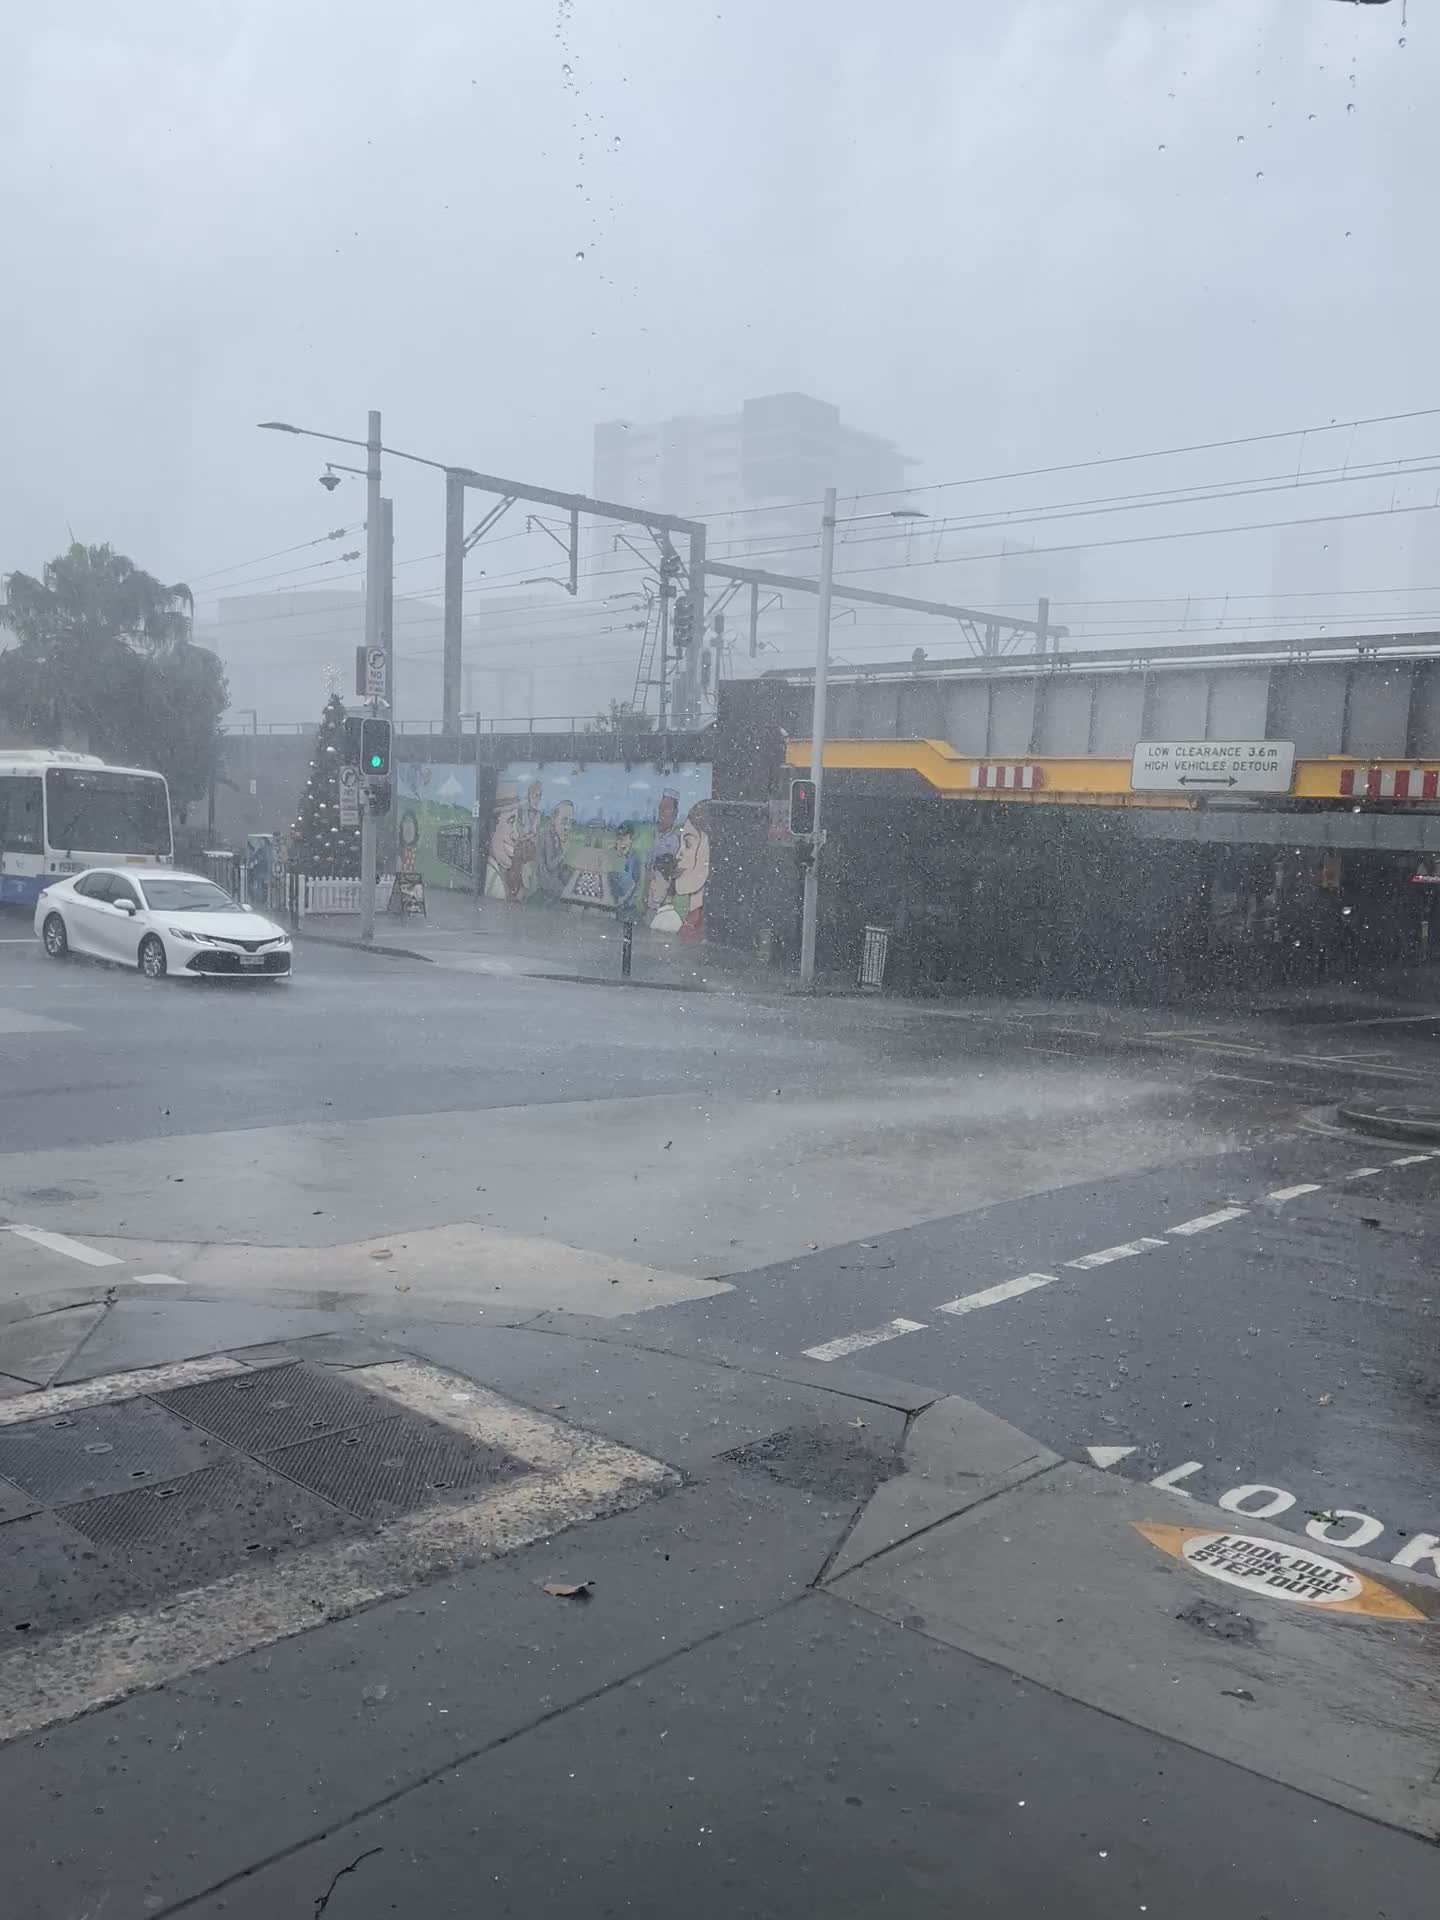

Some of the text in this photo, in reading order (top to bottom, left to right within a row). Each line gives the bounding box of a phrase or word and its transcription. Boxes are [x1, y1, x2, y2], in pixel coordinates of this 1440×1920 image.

[1144, 761, 1279, 772] HIGH VEHICLES DETOUR
[1148, 747, 1278, 757] LOW CLEARANCE 3.6m
[1150, 1461, 1440, 1579] LOOK
[1203, 1543, 1292, 1576] BEFORE
[1214, 1535, 1291, 1564] LOOK
[1188, 1549, 1332, 1599] STEP OUT
